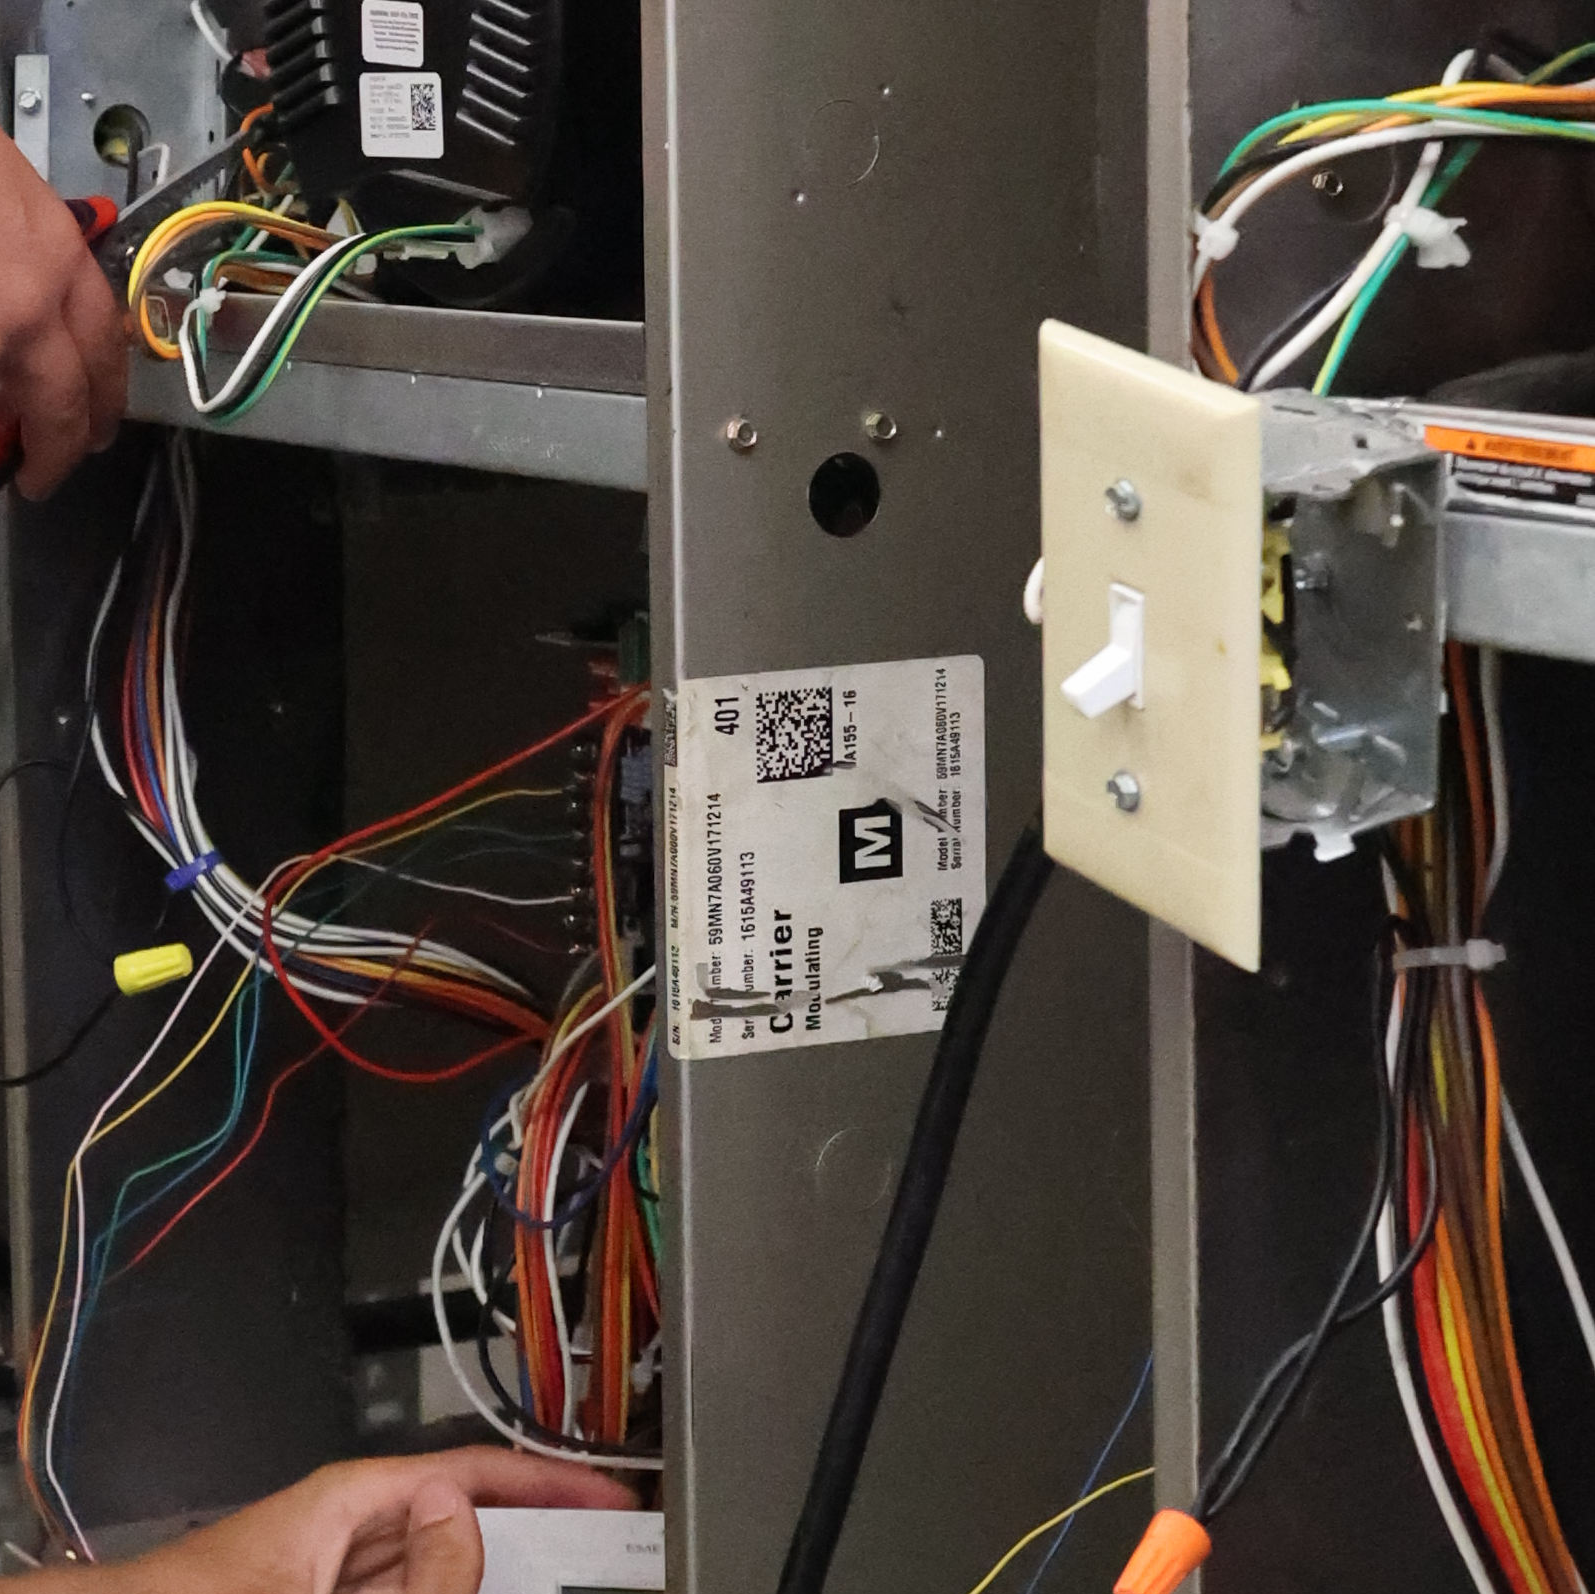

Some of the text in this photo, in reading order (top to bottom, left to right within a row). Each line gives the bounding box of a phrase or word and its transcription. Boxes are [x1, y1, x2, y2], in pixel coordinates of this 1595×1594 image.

[714, 697, 739, 735] 401
[706, 792, 722, 945] 59MN7A060V171214
[854, 814, 891, 870] M
[937, 837, 948, 870] Model
[740, 852, 755, 940] 1615A49113
[741, 949, 754, 998] umber:
[769, 909, 793, 1034] Carrier
